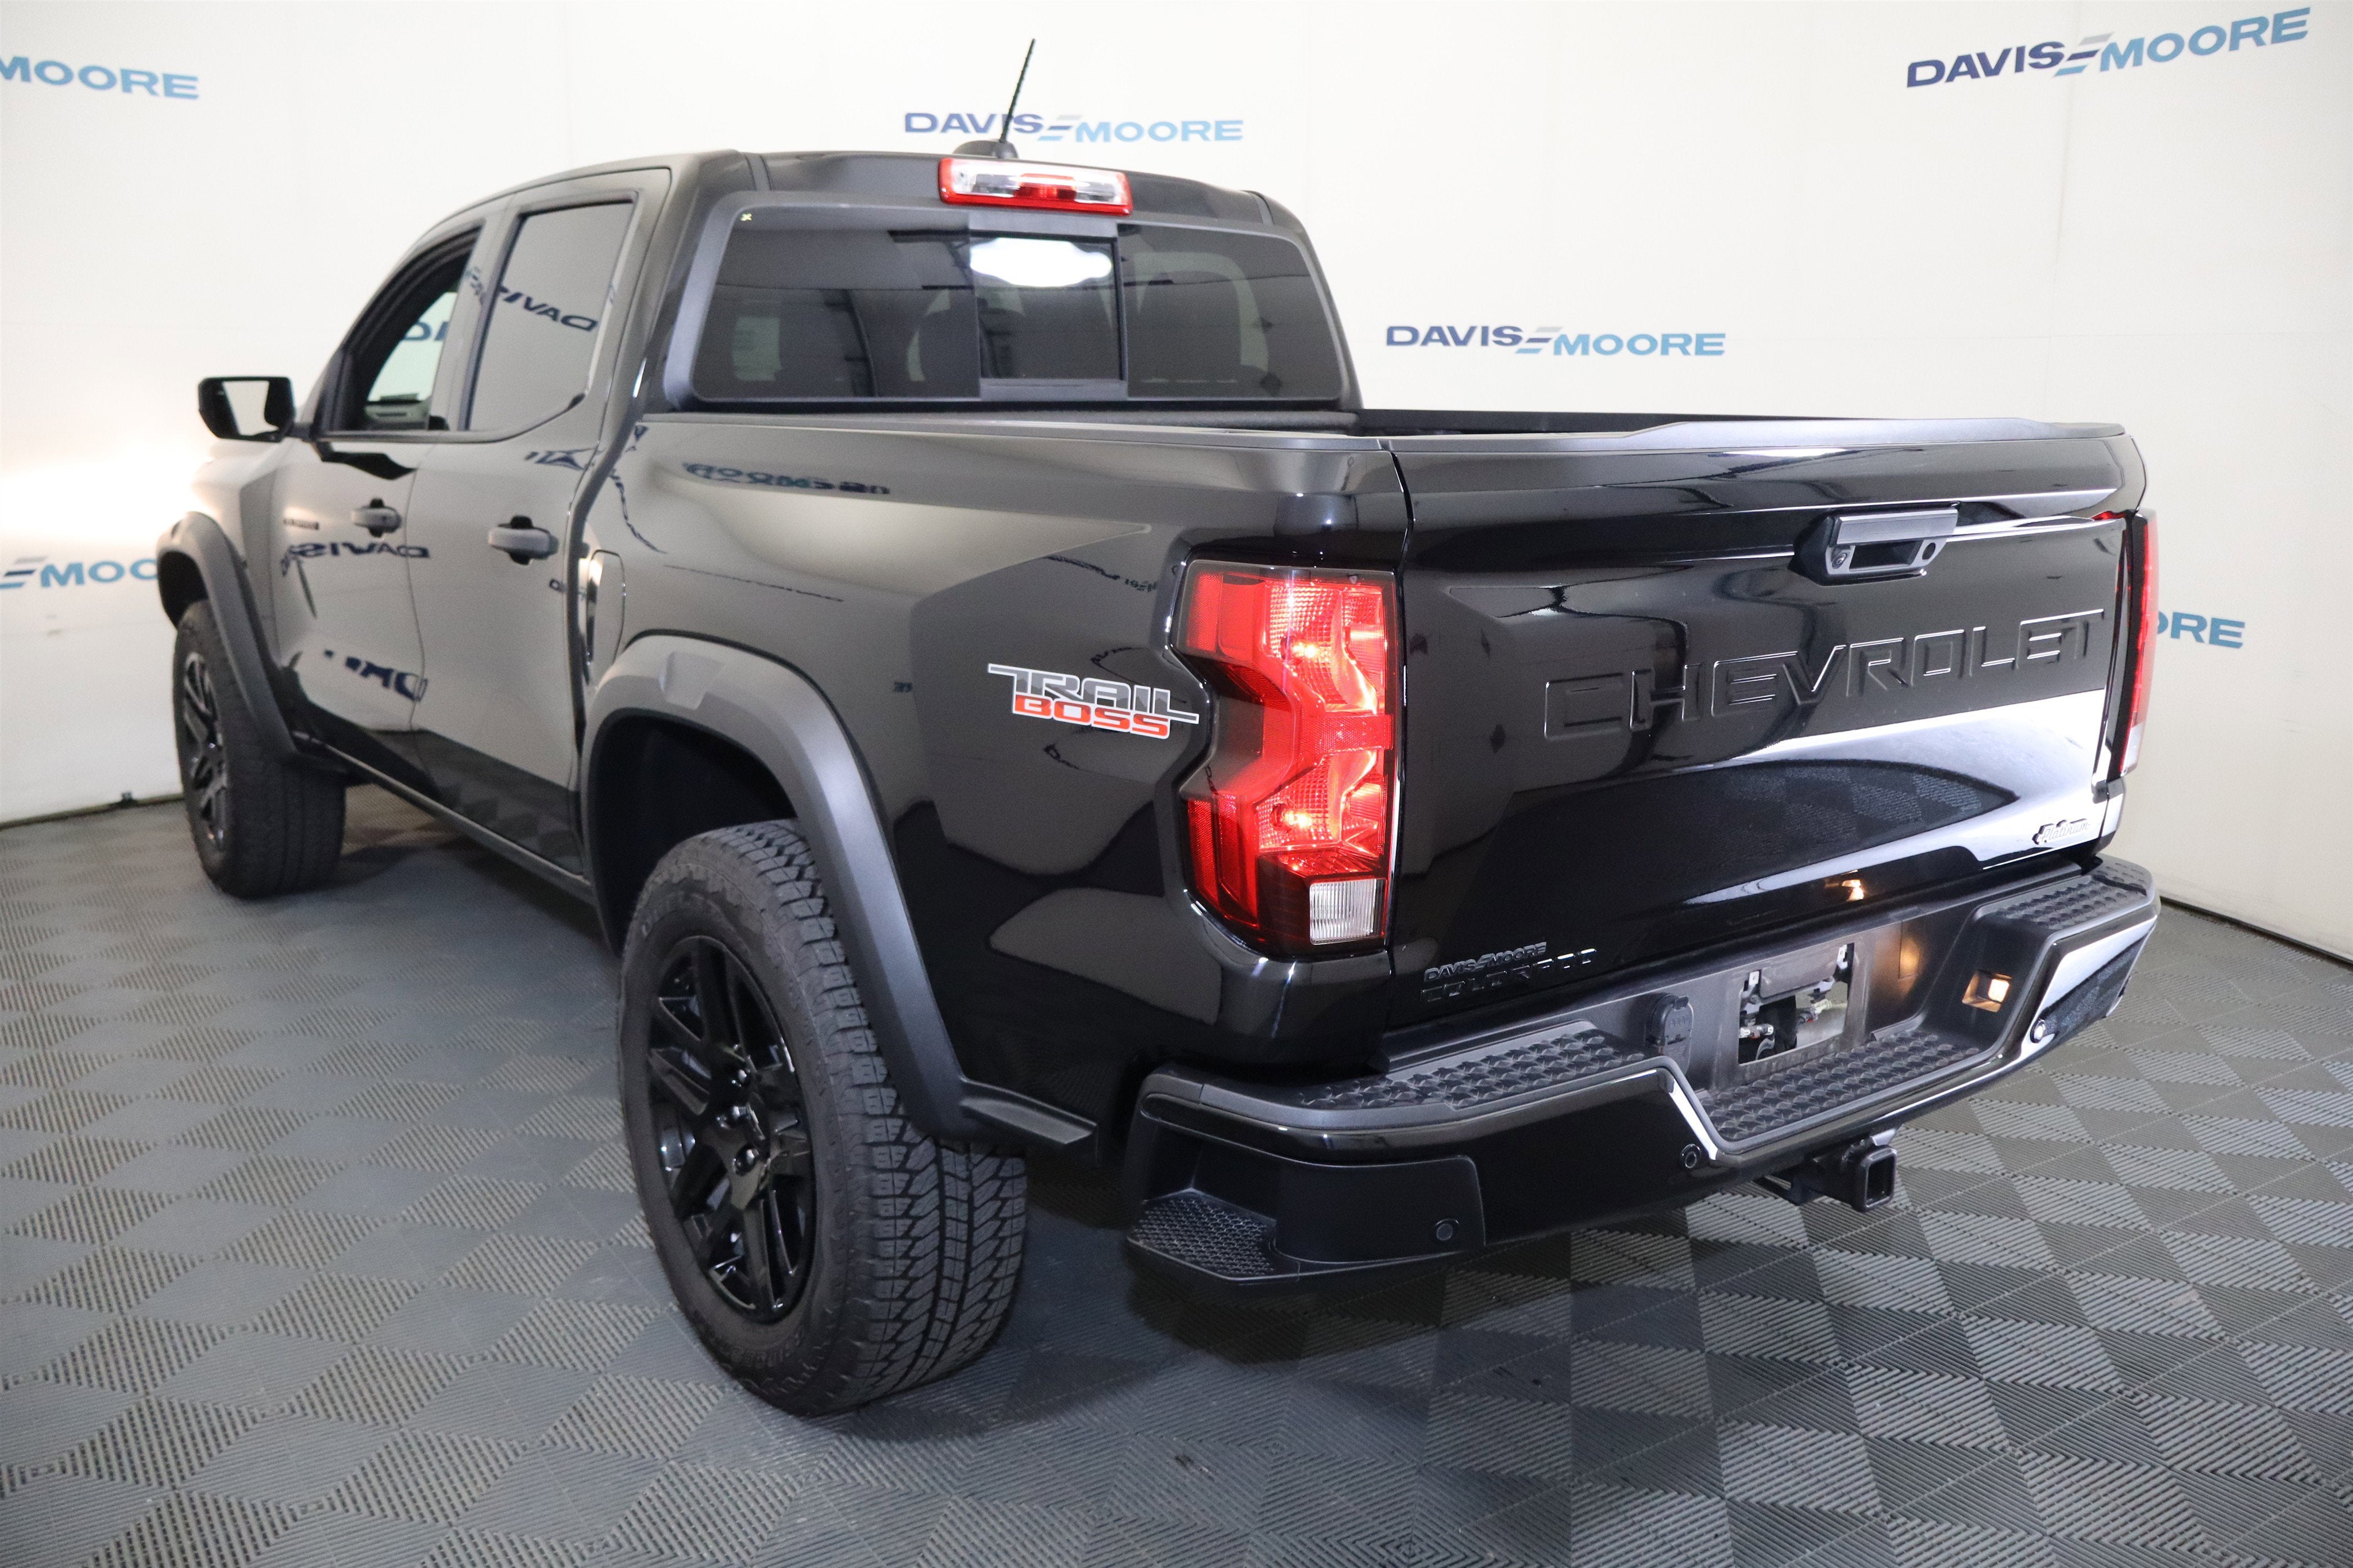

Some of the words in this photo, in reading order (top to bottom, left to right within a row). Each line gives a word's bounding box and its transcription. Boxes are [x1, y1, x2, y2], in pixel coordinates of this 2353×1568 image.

[1908, 41, 2064, 88] DAVIS
[2099, 7, 2310, 72] MOORE
[0, 56, 199, 100] MOORE
[1075, 120, 1244, 142] MOORE
[1387, 326, 1523, 346] DAVIS
[1553, 333, 1726, 357] MOORE
[40, 558, 157, 588] MOO
[988, 663, 1199, 724] TRAIL
[1544, 609, 2104, 741] CHEVROLET
[1012, 691, 1170, 739] BOSS
